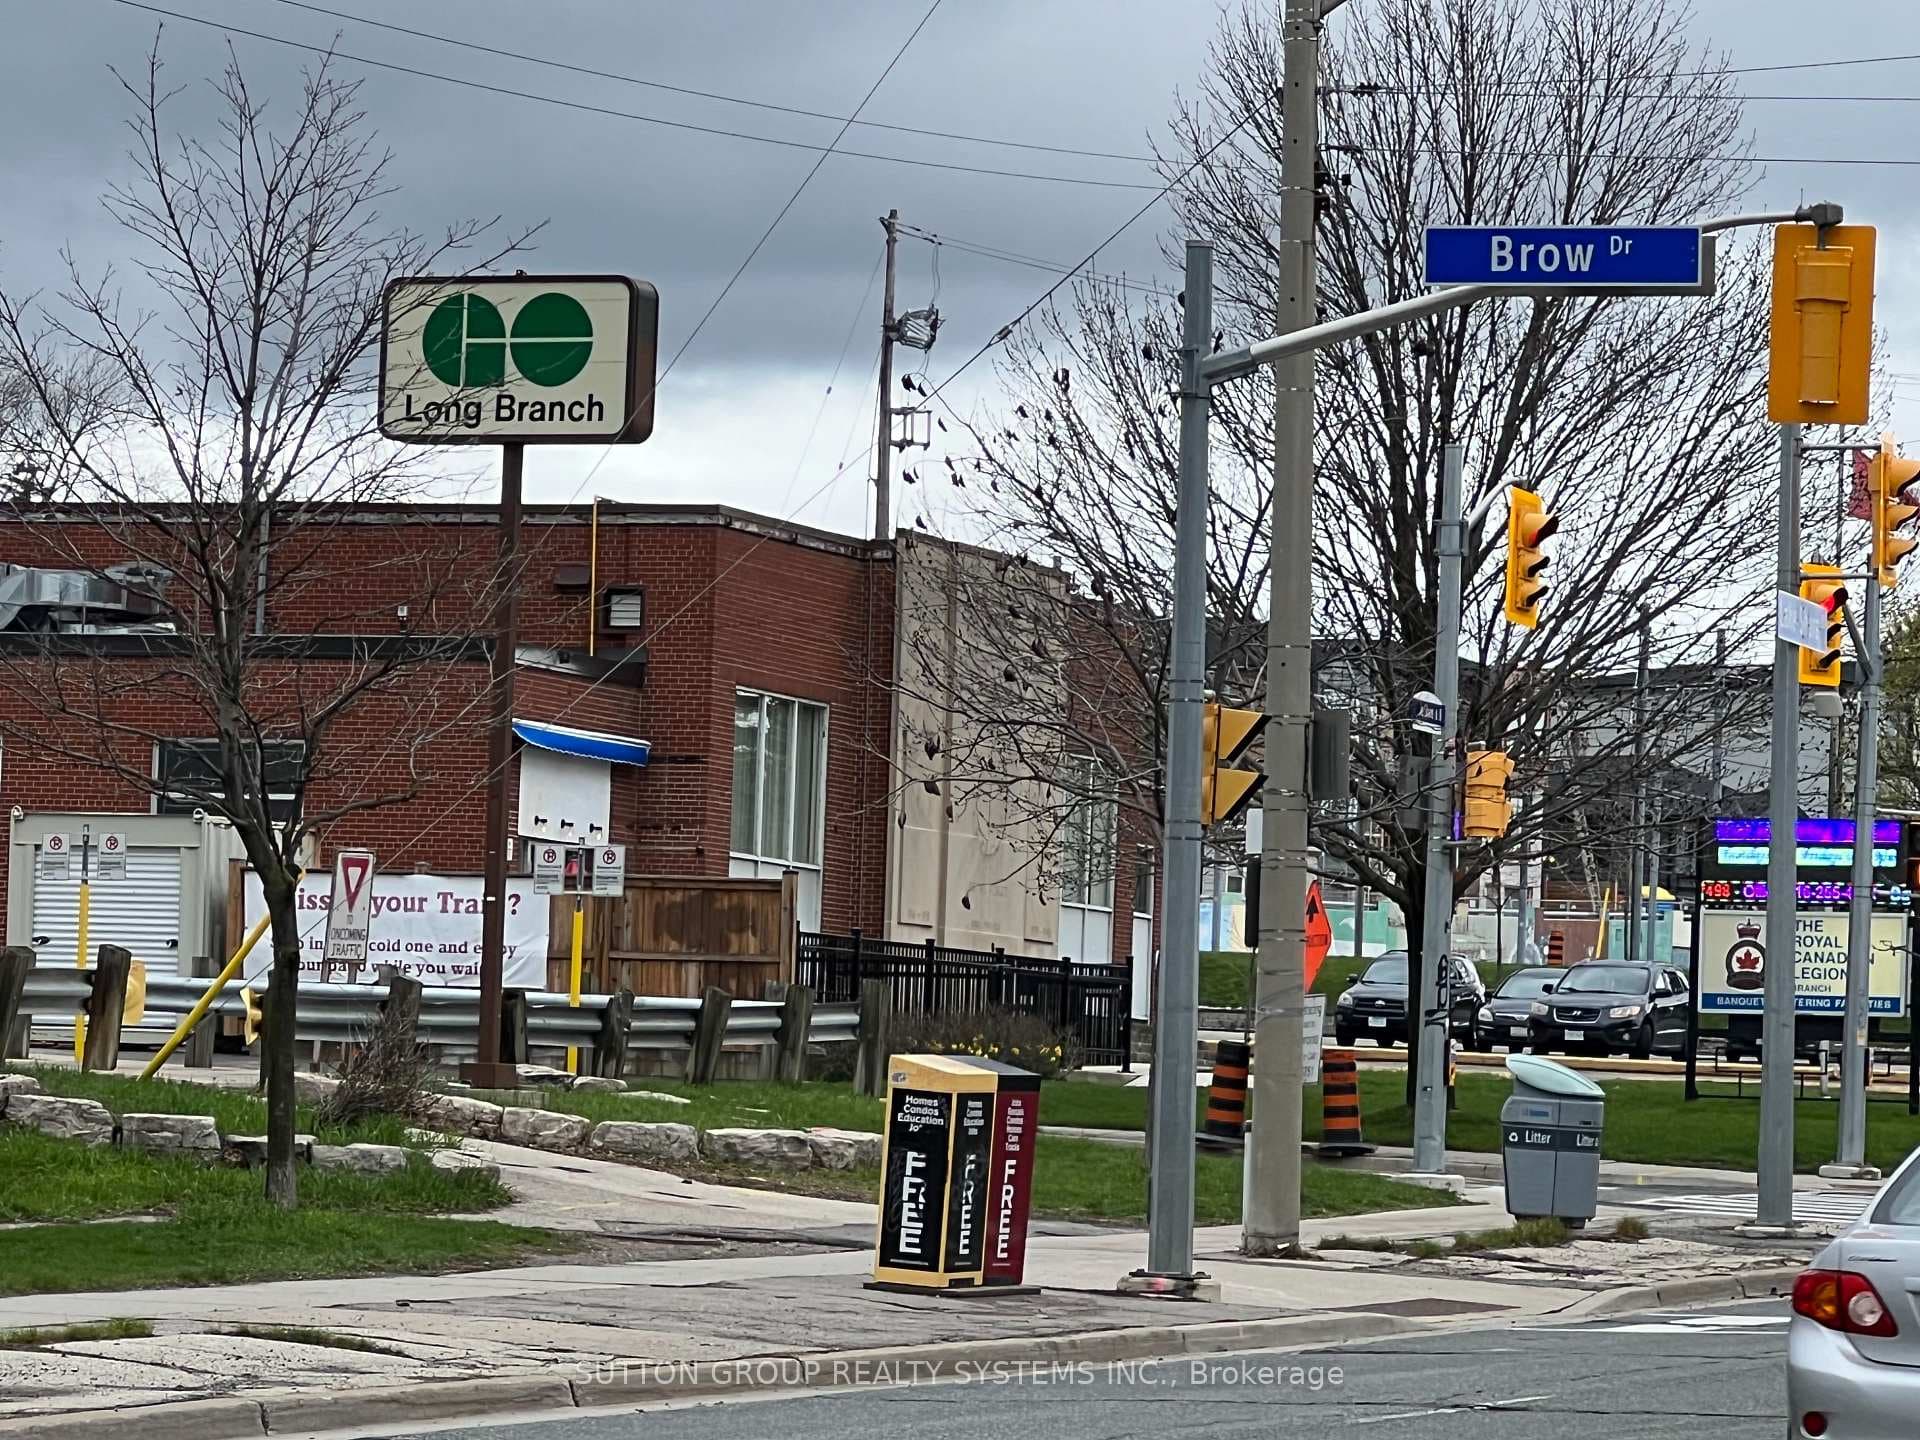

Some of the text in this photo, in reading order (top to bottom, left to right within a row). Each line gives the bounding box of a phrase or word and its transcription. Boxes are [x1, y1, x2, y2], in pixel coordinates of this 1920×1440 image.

[1490, 235, 1633, 272] Brow Dr
[405, 393, 604, 429] Long Branch
[370, 895, 428, 918] your
[437, 892, 521, 915] Tra?
[1796, 920, 1824, 932] THE
[331, 928, 367, 941] ONCOMING
[309, 935, 324, 949] in
[368, 938, 401, 952] cold
[405, 942, 434, 953] one
[438, 941, 469, 954] and
[331, 942, 362, 957] TRAFFIC
[416, 965, 446, 977] you
[451, 963, 478, 976] wai
[1795, 984, 1832, 993] RANCH
[905, 1095, 939, 1107] Homes
[903, 1104, 939, 1116] Condos
[897, 1112, 944, 1126] Education
[1525, 1130, 1551, 1145] Litter
[899, 1151, 927, 1254] FREE
[997, 1159, 1017, 1259] FREE
